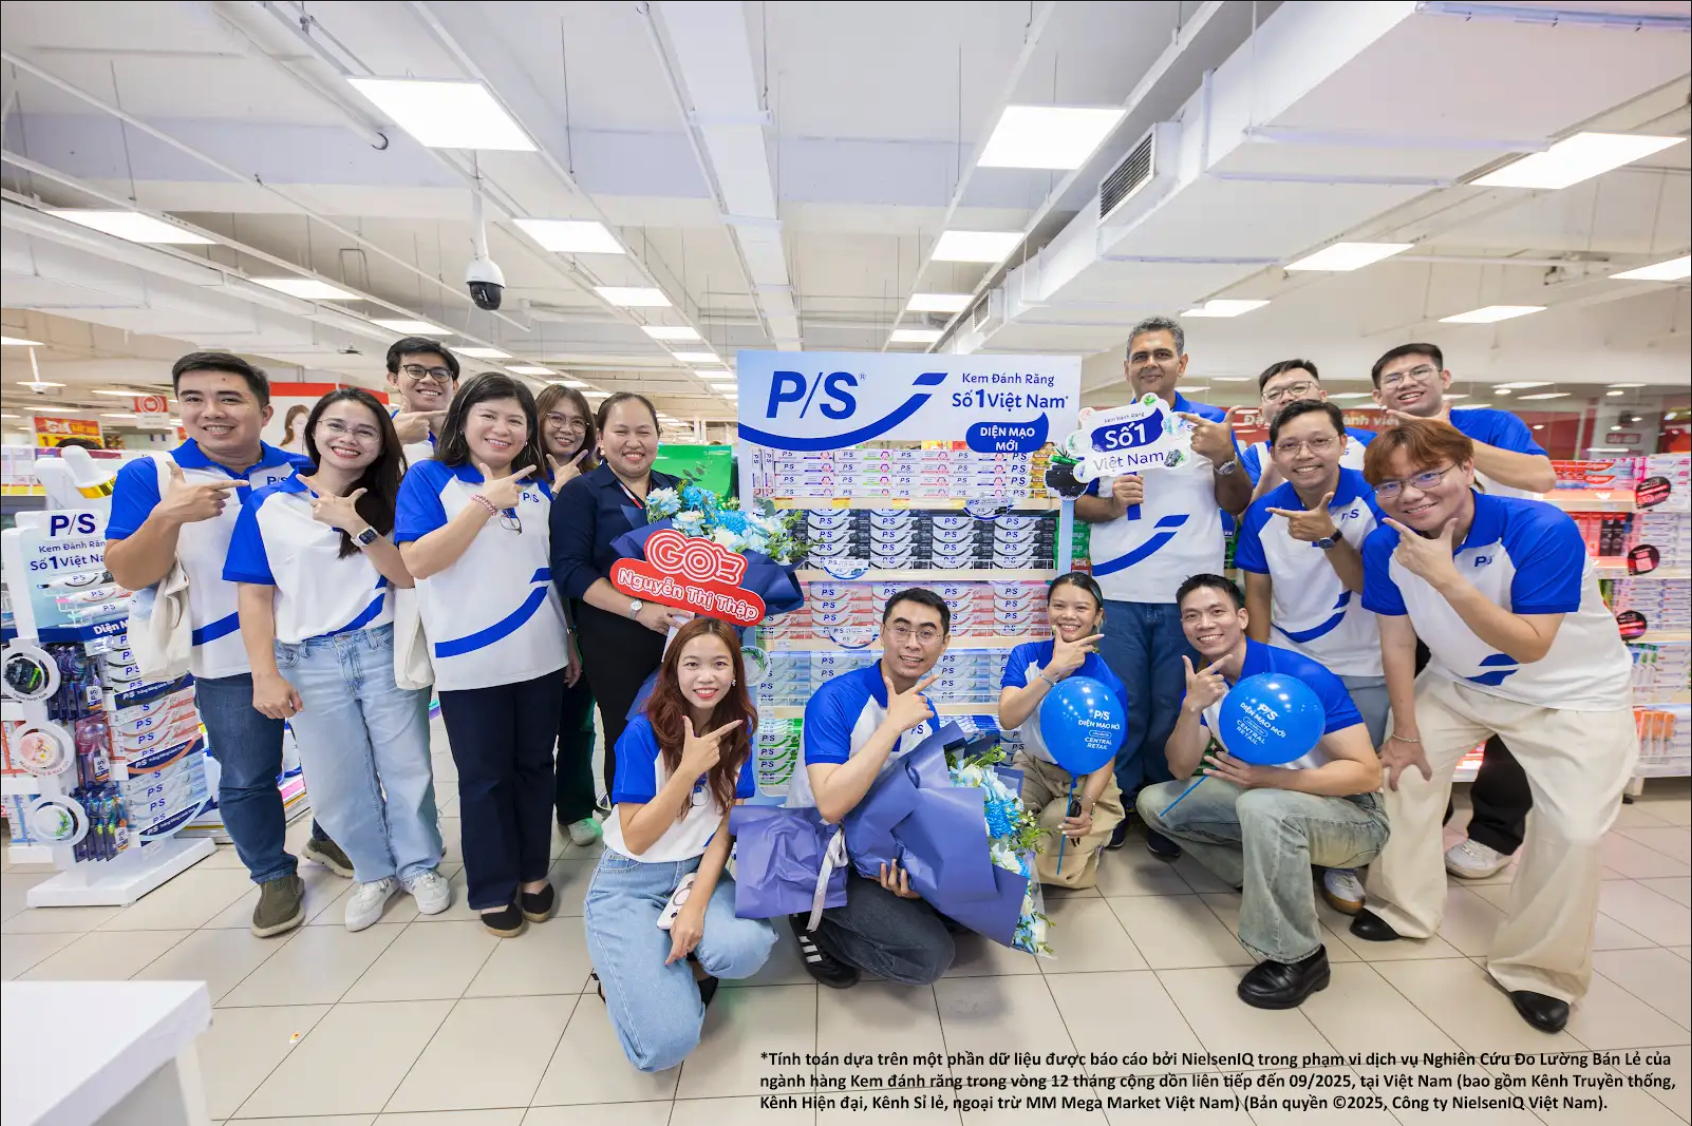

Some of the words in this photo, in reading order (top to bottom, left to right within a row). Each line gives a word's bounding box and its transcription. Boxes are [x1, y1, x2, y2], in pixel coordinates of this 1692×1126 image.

[963, 373, 988, 383] Kem
[992, 373, 1021, 383] Đánh
[1026, 374, 1054, 387] Răng
[952, 388, 974, 408] Số
[988, 391, 1021, 412] Việt
[980, 424, 1006, 438] DIỆN
[1008, 427, 1035, 440] MẠO
[996, 439, 1018, 452] MỚI
[1094, 454, 1124, 473] Việt
[1128, 450, 1164, 467] Nam
[50, 513, 96, 536] P/S
[63, 541, 87, 550] Đánh
[89, 540, 106, 548] Răn
[30, 556, 48, 571] Số
[60, 556, 88, 568] Việt
[90, 554, 104, 563] Na
[618, 567, 683, 600] Nguyễn
[686, 585, 714, 611] Thị
[716, 594, 758, 621] Thập
[93, 622, 119, 635] Diện
[1236, 720, 1265, 744] CENTRAL
[1084, 737, 1112, 746] CENTRAL
